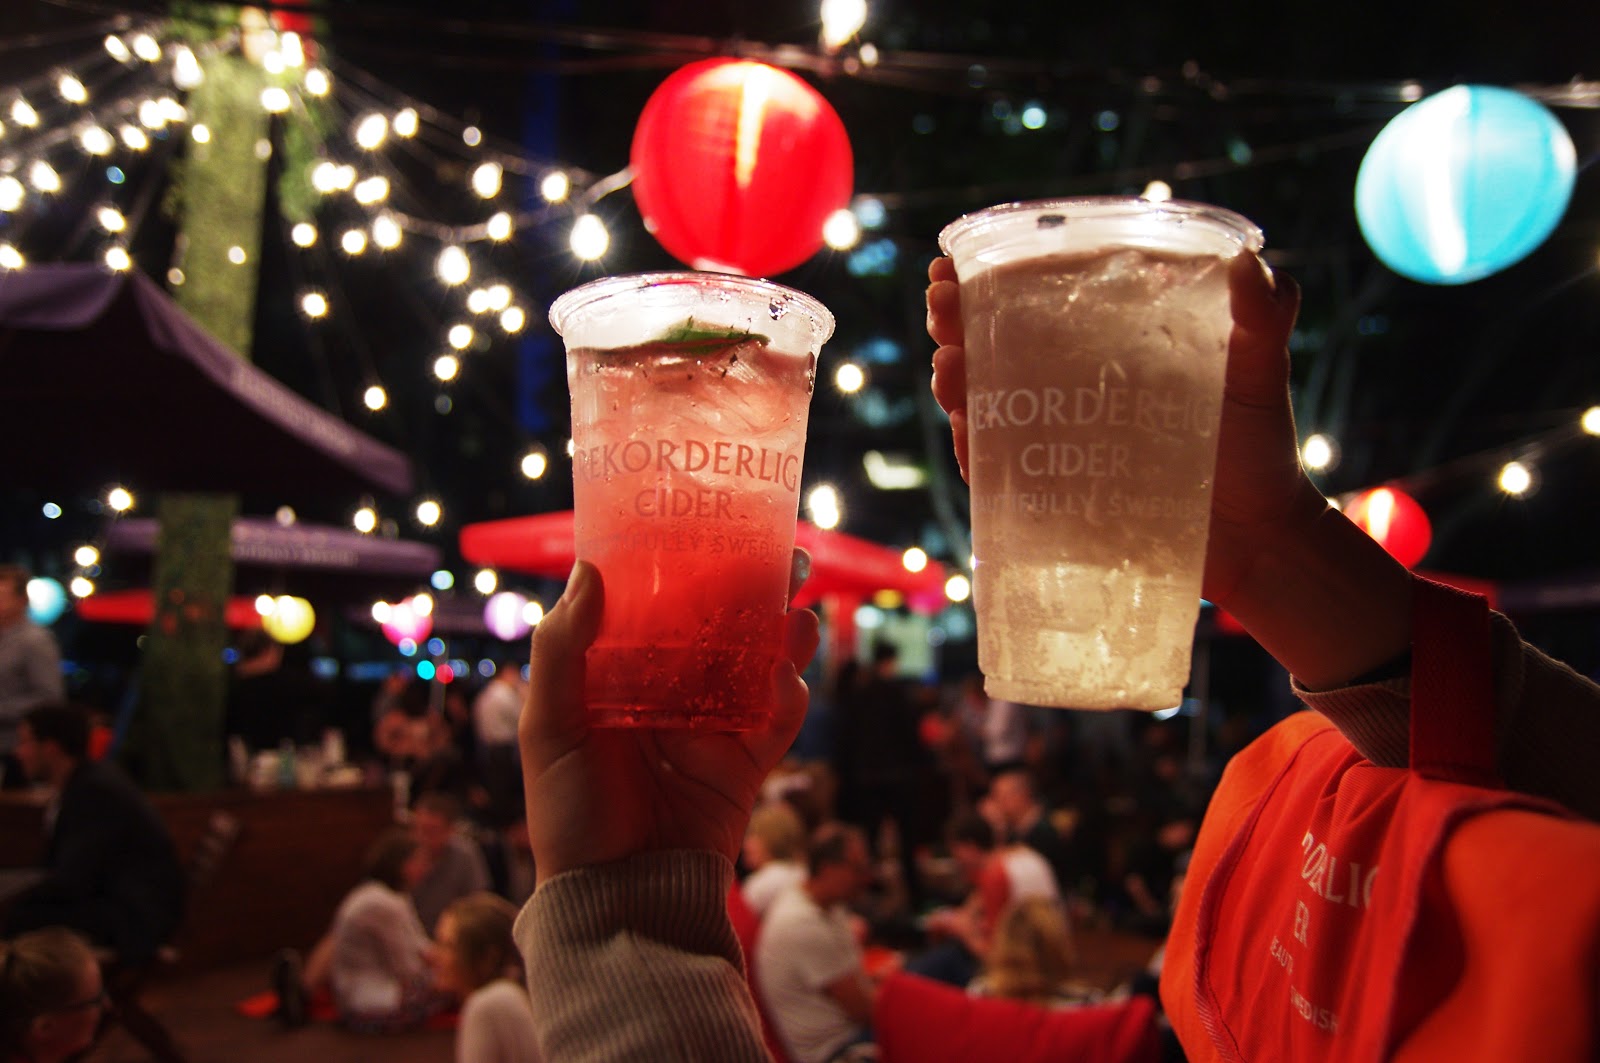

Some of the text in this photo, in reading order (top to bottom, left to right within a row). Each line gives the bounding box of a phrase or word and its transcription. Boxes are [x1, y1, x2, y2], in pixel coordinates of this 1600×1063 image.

[970, 386, 1216, 439] EKORDERLIG
[1020, 442, 1131, 478] CIDER
[634, 488, 734, 520] CIDER
